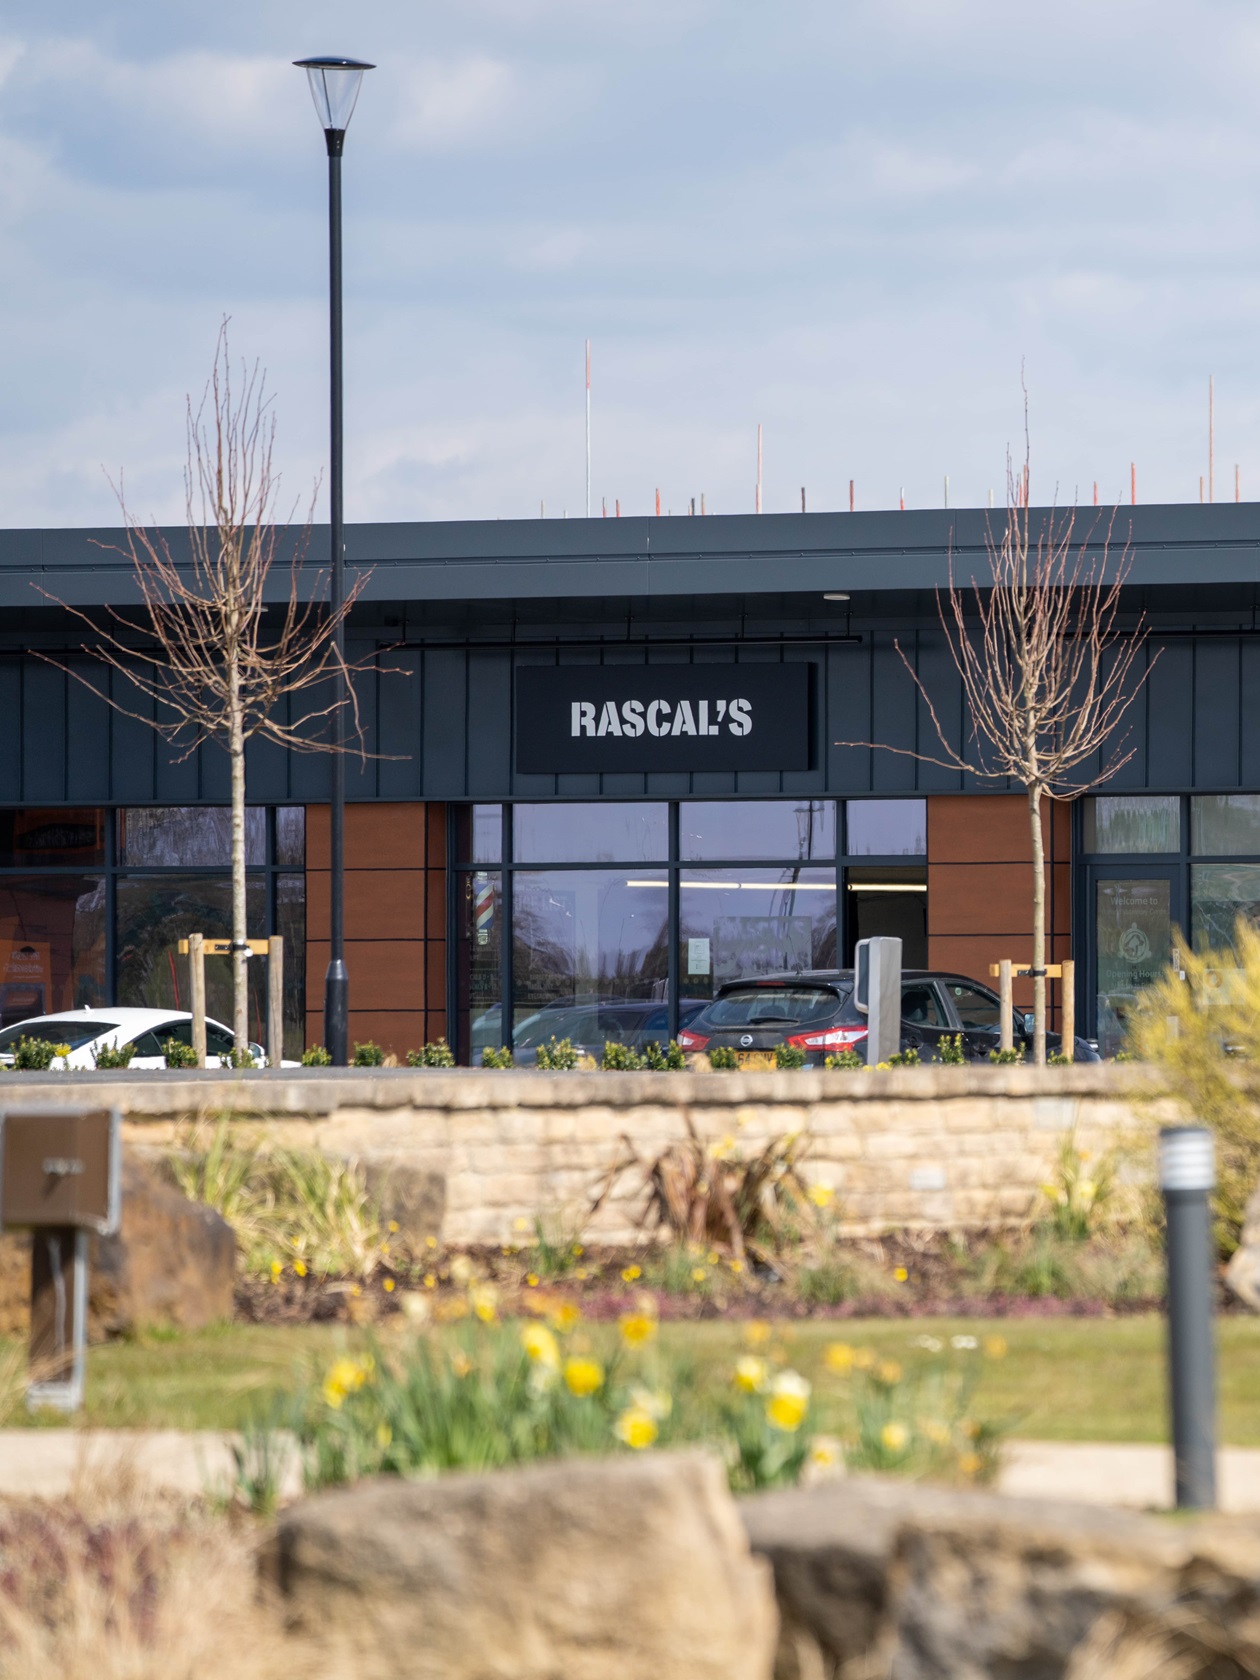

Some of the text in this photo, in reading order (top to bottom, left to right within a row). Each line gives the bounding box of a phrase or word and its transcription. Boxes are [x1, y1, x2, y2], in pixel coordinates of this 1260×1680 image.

[571, 698, 753, 737] RASCAL'S
[1110, 896, 1158, 905] Welcome to
[1106, 970, 1138, 980] Opening
